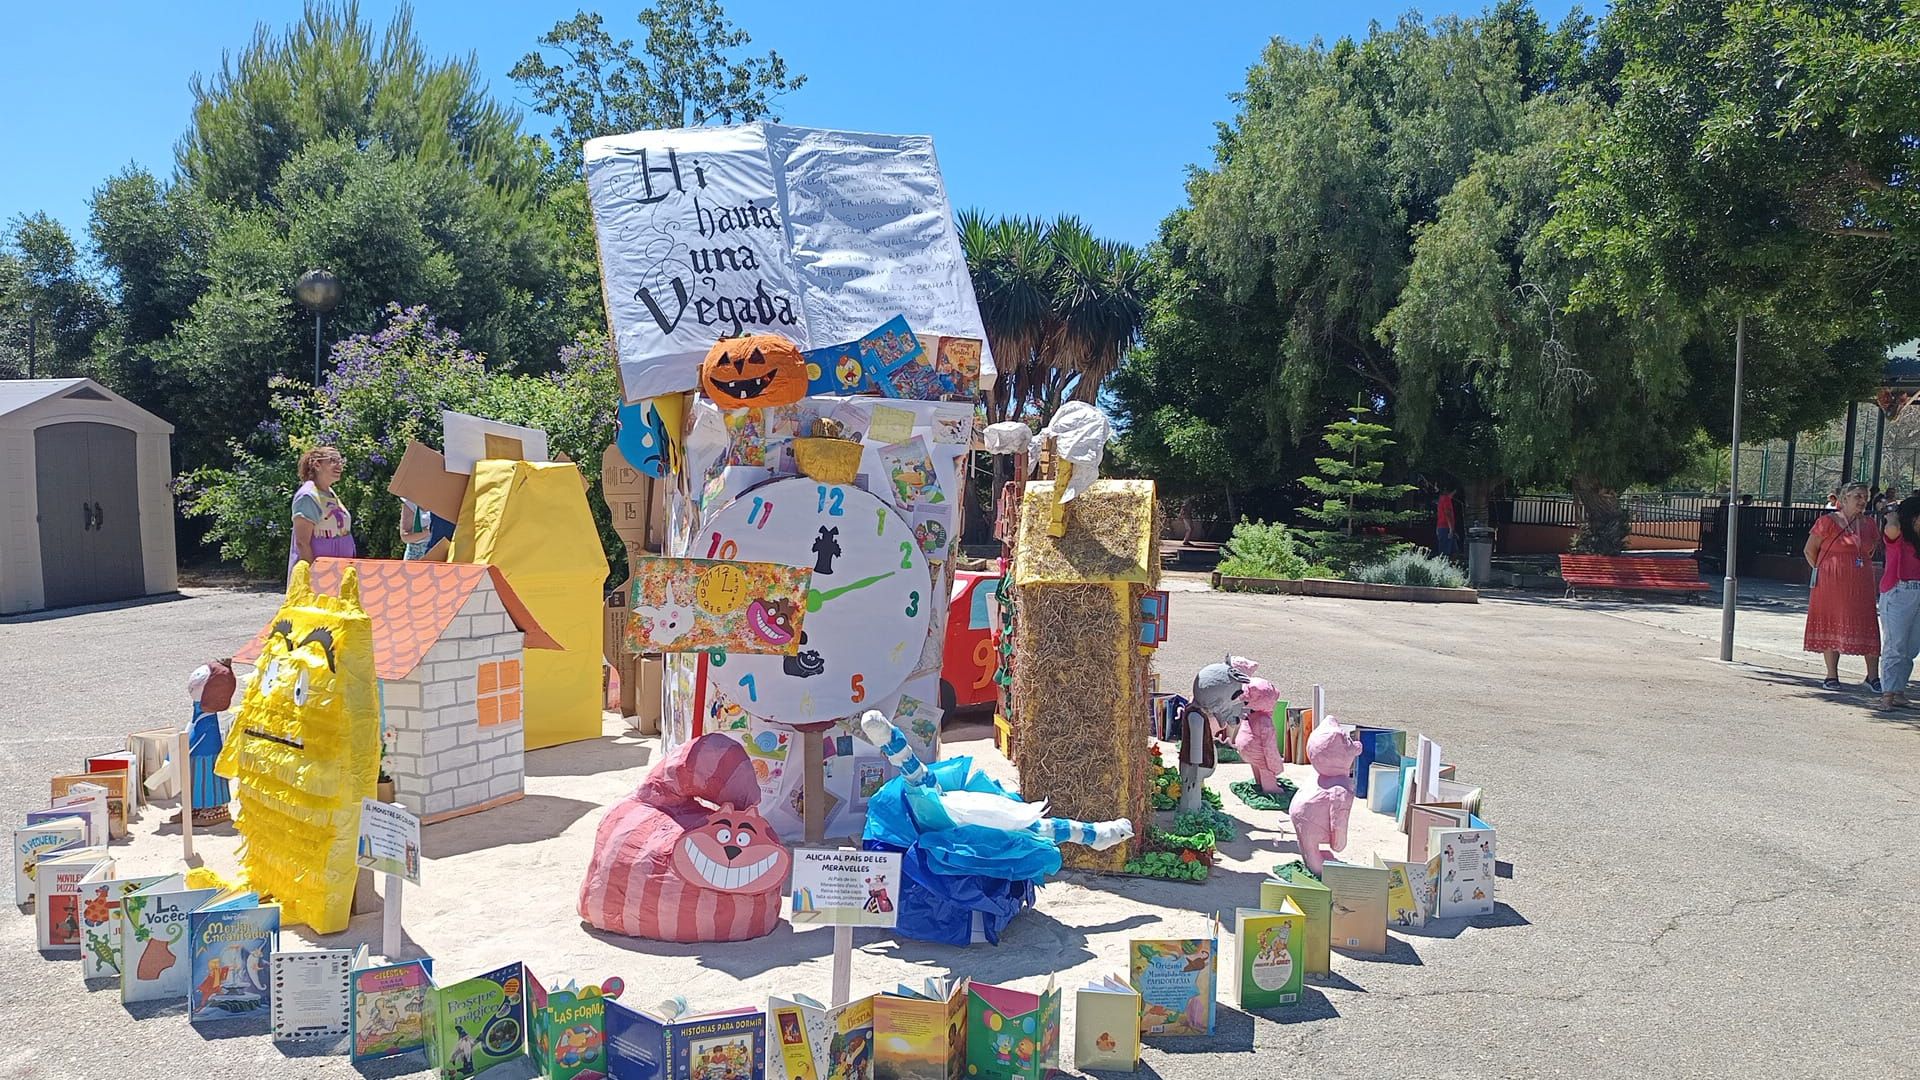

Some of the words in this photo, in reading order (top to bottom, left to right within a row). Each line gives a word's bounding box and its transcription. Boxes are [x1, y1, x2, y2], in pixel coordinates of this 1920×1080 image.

[612, 147, 708, 204] Hi
[689, 246, 760, 274] una
[634, 277, 797, 337] Vegada
[748, 496, 773, 530] 11
[817, 486, 844, 516] 12
[876, 507, 887, 536] 1
[707, 532, 737, 560] 10
[899, 541, 913, 569] 2
[700, 588, 707, 598] 9
[905, 590, 920, 617] 3
[851, 673, 865, 703] 5
[805, 853, 831, 861] ALICIA
[863, 855, 873, 863] DE
[874, 856, 888, 864] LES
[821, 864, 870, 873] MERAVELLES
[145, 912, 188, 925] Voceci
[156, 897, 179, 914] La
[448, 990, 497, 1014] Bosque
[554, 1008, 573, 1025] LAS
[574, 1002, 605, 1021] FORMA
[717, 1021, 735, 1032] PARA
[736, 1017, 763, 1029] DORMIR
